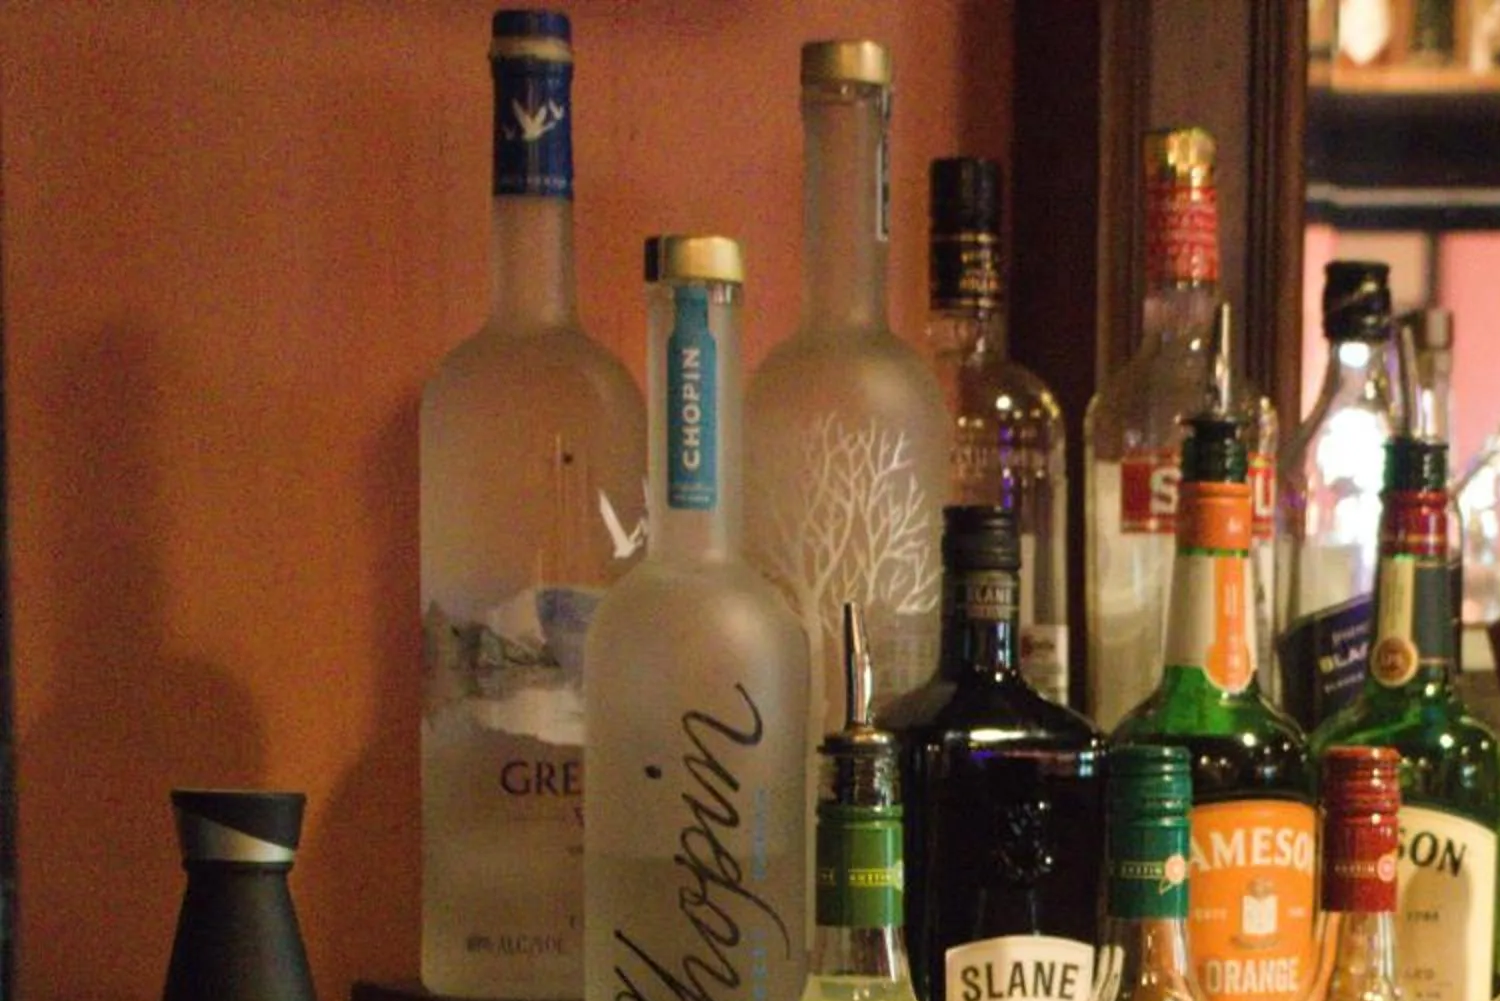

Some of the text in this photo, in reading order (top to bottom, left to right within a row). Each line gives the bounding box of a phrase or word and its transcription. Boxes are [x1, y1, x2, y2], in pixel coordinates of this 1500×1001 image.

[682, 346, 700, 471] CHOPIN
[500, 760, 582, 796] GRE
[1190, 827, 1313, 872] AMESO
[1206, 957, 1299, 994] ORANGE
